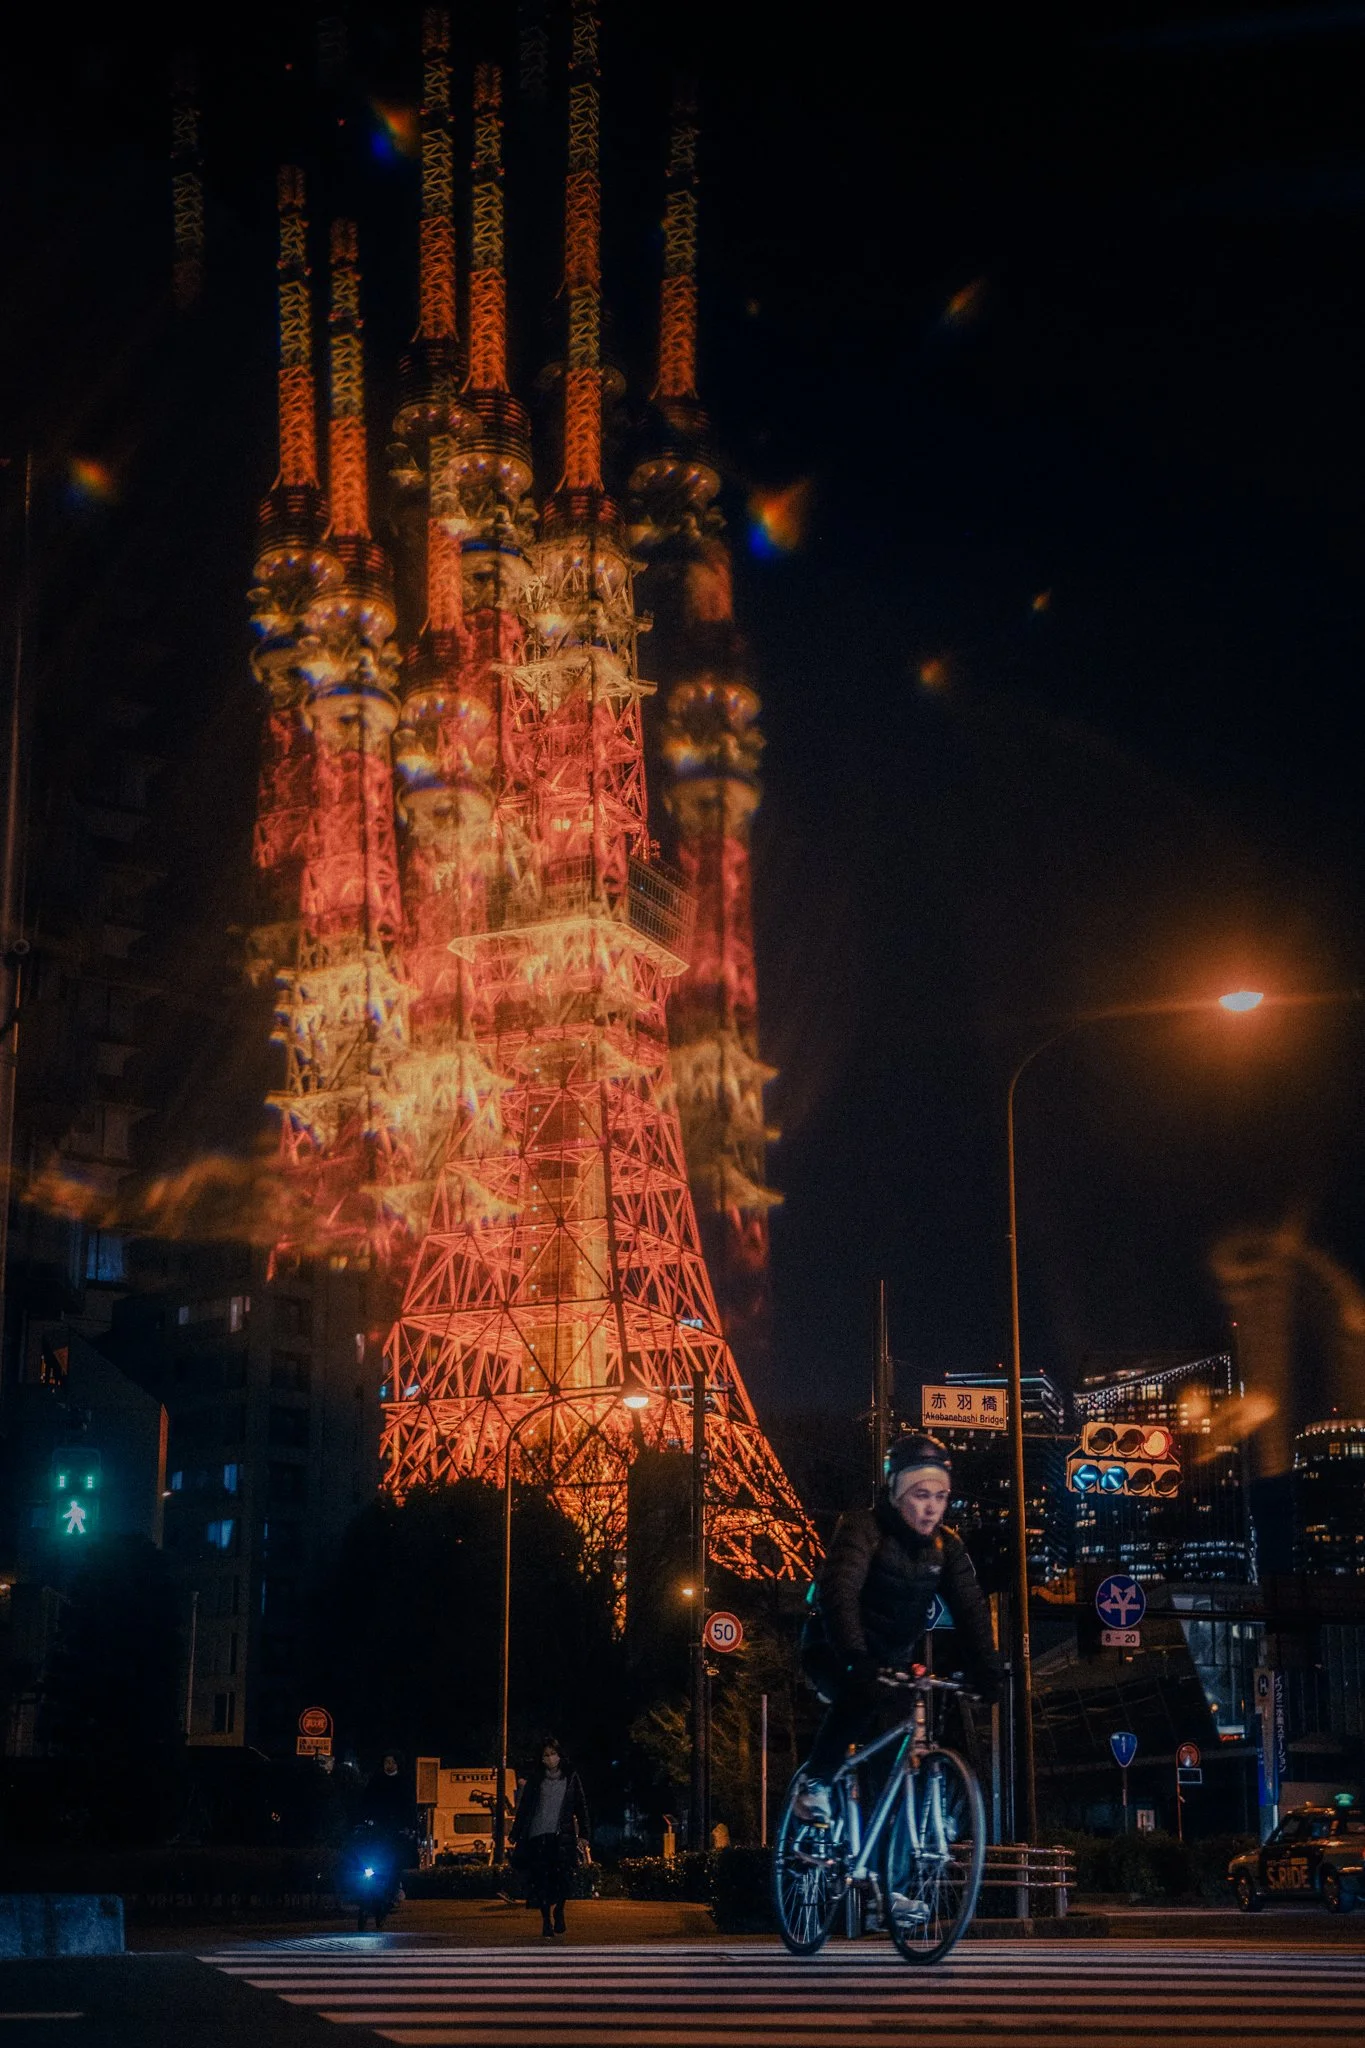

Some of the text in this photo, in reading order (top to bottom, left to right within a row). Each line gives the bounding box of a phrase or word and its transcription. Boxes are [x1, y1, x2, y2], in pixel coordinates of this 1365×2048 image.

[931, 1393, 998, 1411] 赤羽橋
[925, 1411, 1005, 1425] Akabanebashi Bridge
[713, 1623, 734, 1641] 50
[1105, 1633, 1112, 1643] 8
[1124, 1633, 1136, 1643] 20
